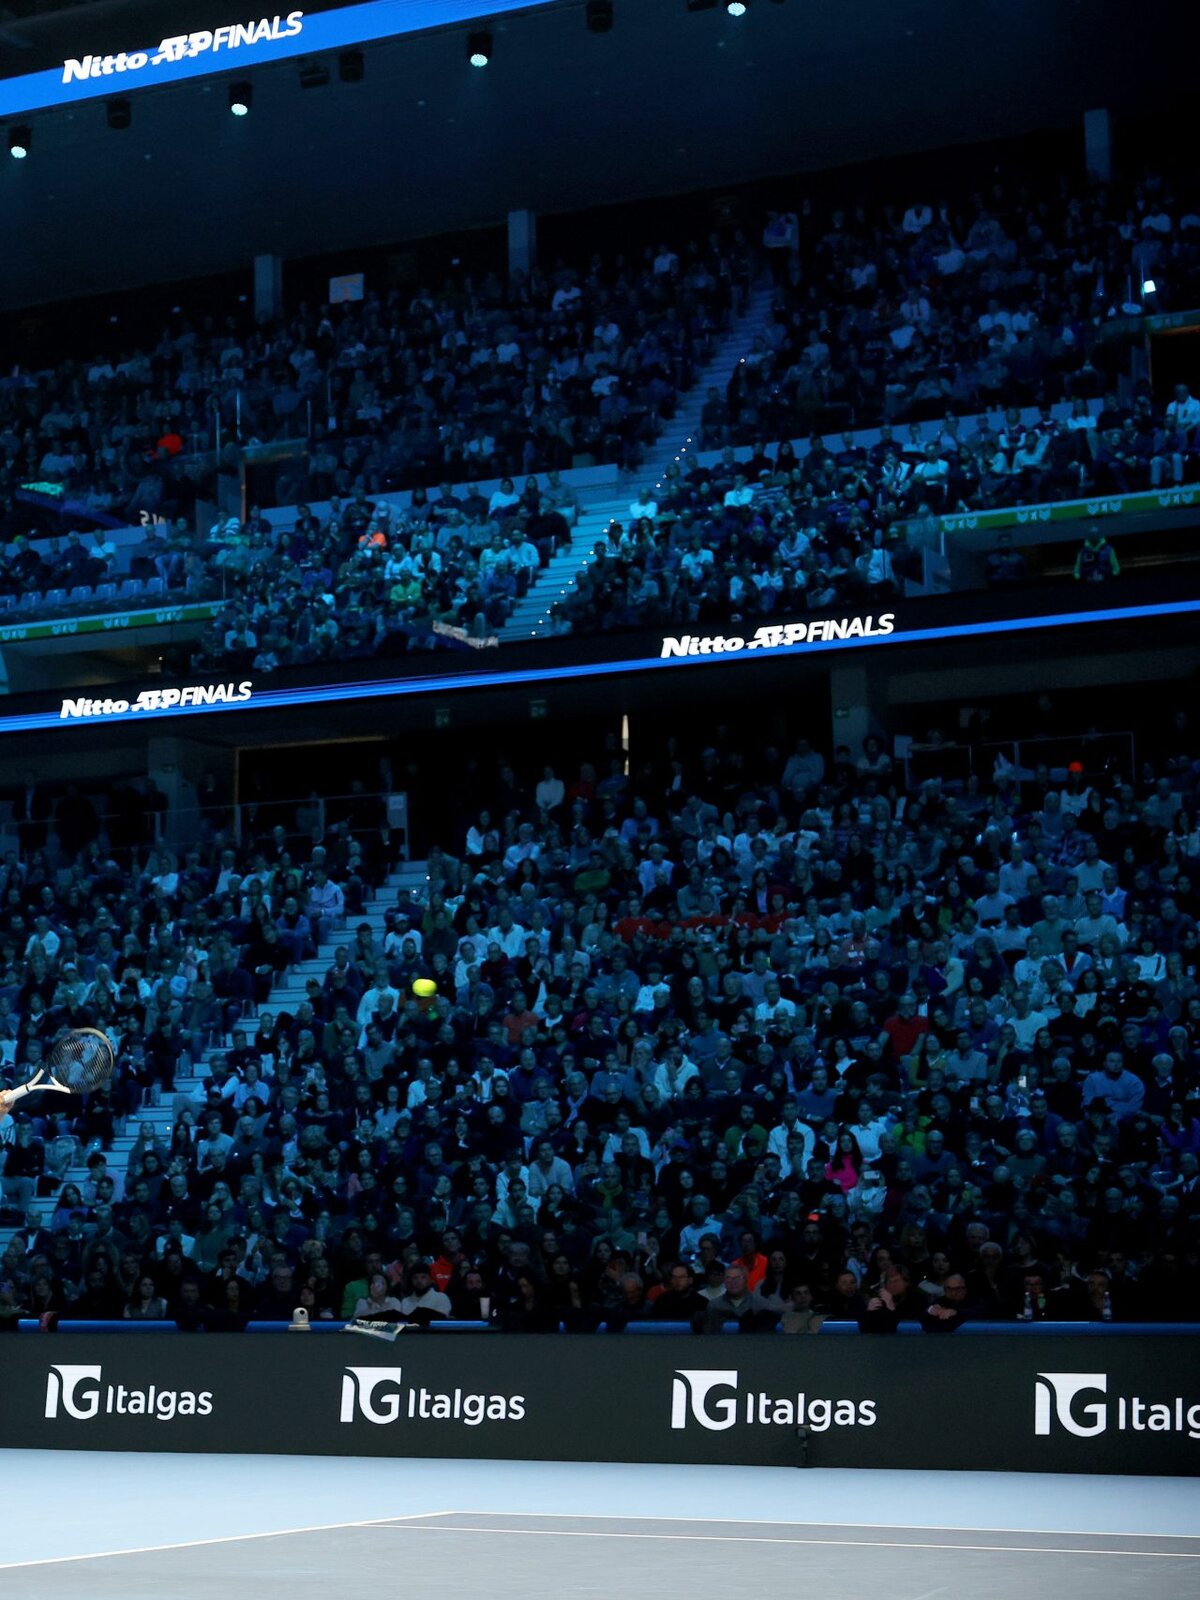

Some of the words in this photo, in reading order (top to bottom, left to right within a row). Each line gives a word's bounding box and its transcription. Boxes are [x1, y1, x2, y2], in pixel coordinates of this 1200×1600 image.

[62, 53, 148, 83] Nitto
[661, 635, 745, 658] Nitto
[60, 698, 129, 719] Nitto
[106, 1385, 213, 1421] Italgas
[408, 1388, 526, 1426] Italgas
[746, 1392, 877, 1432] Italgas
